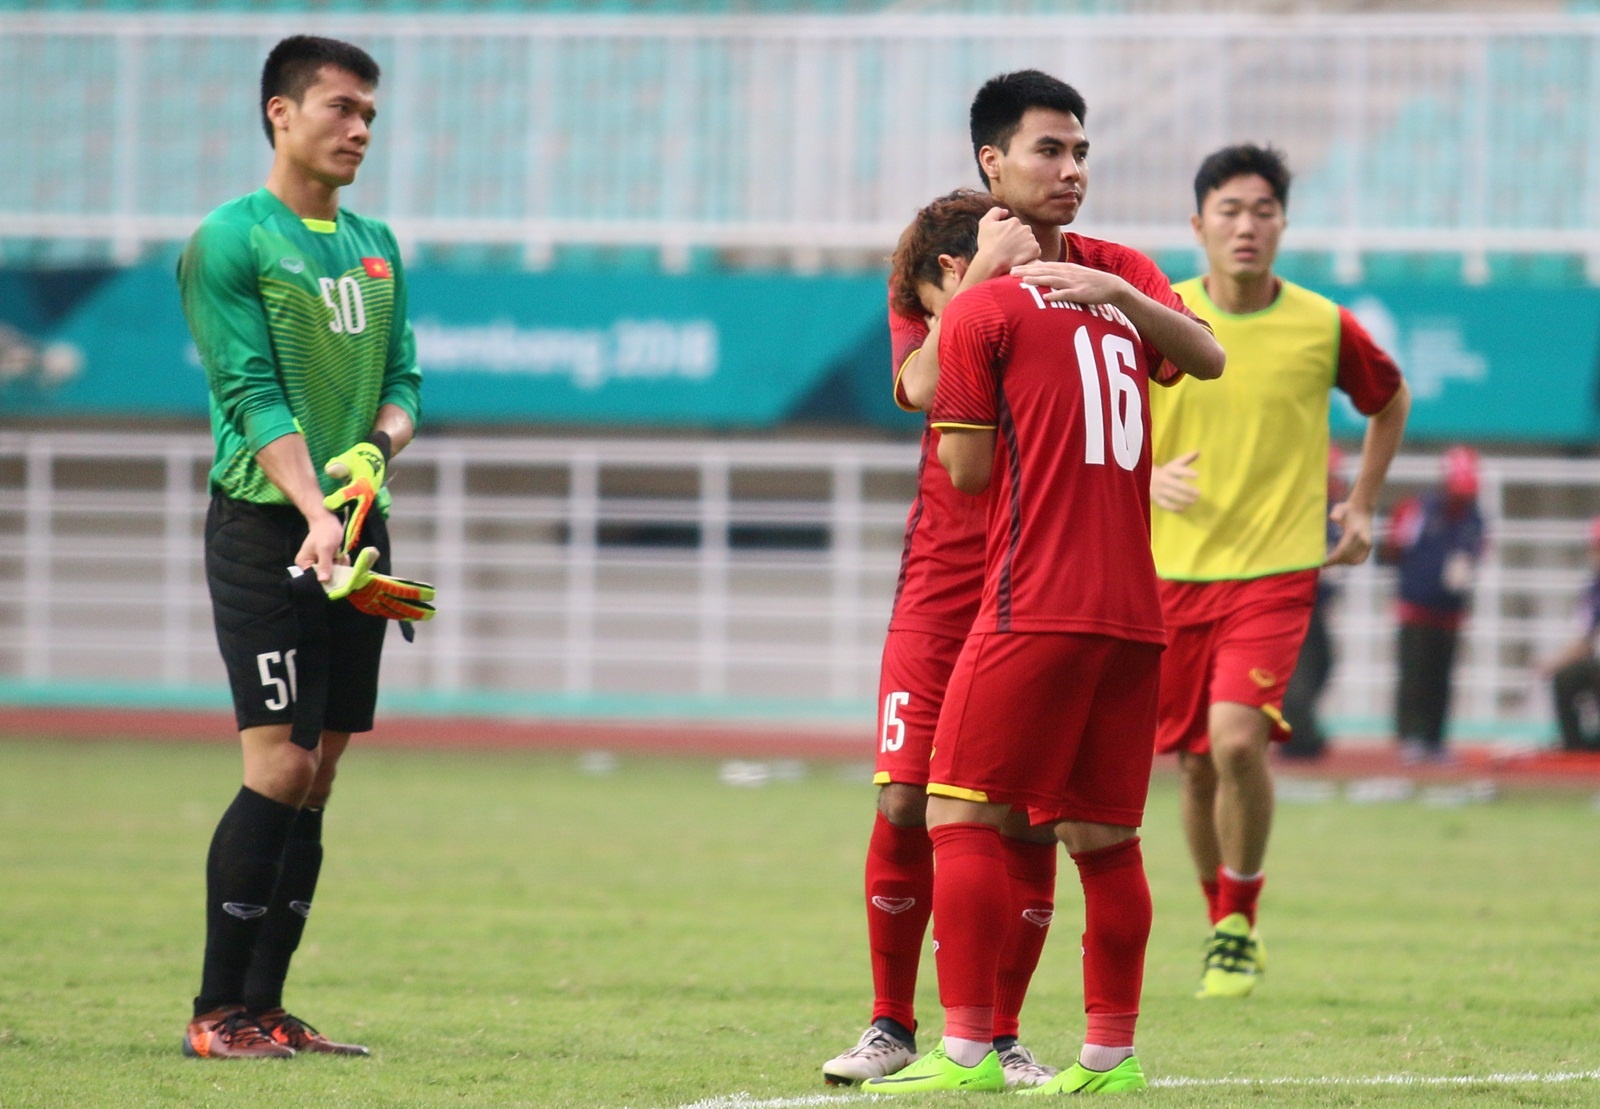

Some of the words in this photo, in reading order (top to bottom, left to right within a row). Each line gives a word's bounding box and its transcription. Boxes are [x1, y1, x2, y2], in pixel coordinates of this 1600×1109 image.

[318, 276, 366, 334] 50
[1073, 325, 1144, 472] 16
[880, 691, 910, 753] 15
